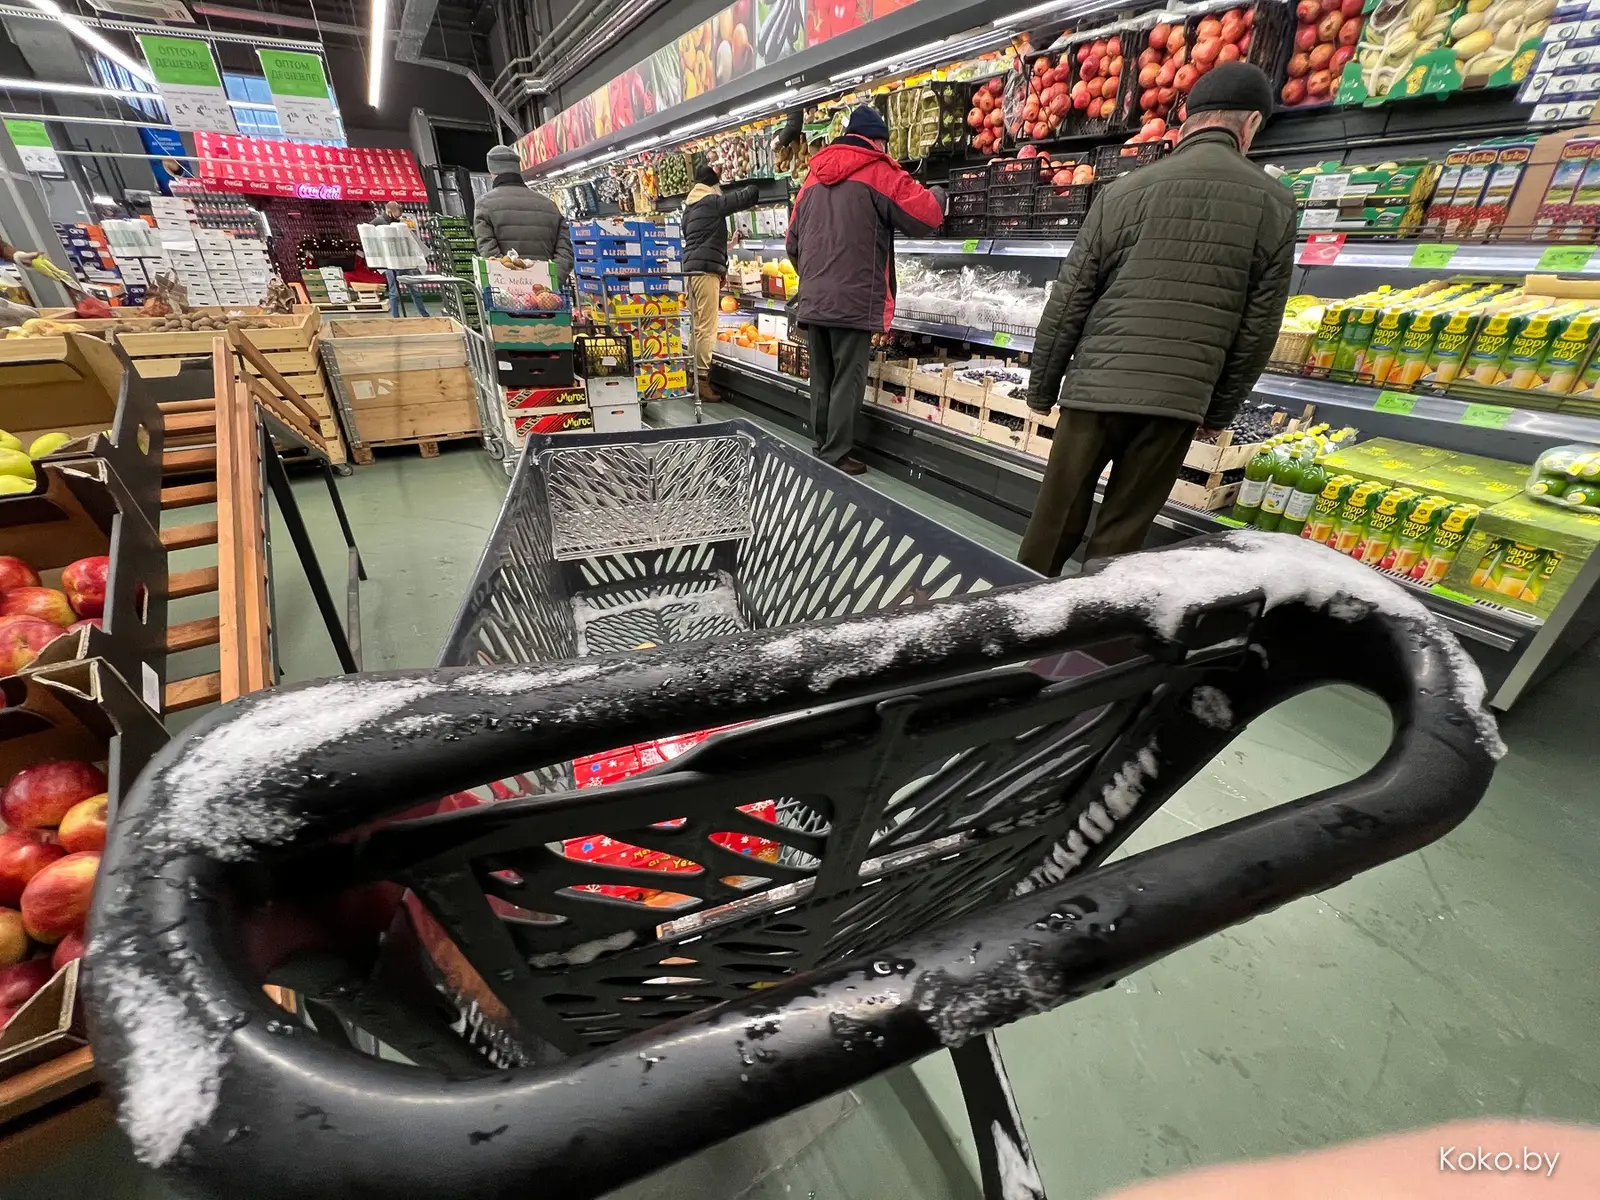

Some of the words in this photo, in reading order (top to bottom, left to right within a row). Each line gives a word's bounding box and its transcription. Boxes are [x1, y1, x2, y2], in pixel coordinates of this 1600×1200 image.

[158, 45, 198, 58] ОПТОМ
[275, 59, 309, 70] ОПТОМ
[1373, 327, 1401, 340] happy
[1404, 330, 1433, 343] happy
[1438, 332, 1469, 345] happy
[1373, 334, 1393, 347] day
[1404, 338, 1425, 350] day
[1438, 340, 1459, 352] day
[1478, 334, 1510, 347] happy
[1512, 334, 1549, 348] happy
[1551, 337, 1588, 352] happy
[1476, 342, 1499, 355] day
[1513, 345, 1537, 358] day
[1552, 347, 1578, 361] day
[556, 392, 586, 404] Maroc
[562, 417, 592, 429] Maroc
[1315, 495, 1341, 509] happy
[1315, 503, 1333, 515] day
[1343, 502, 1369, 517] happy
[1342, 511, 1360, 522] day
[1370, 510, 1398, 525] happy
[1370, 519, 1390, 531] day
[1401, 518, 1432, 534] happy
[1401, 527, 1422, 540] day
[1433, 526, 1465, 543] happy
[1433, 536, 1456, 549] day
[1506, 543, 1541, 561] happy
[1505, 554, 1530, 568] day
